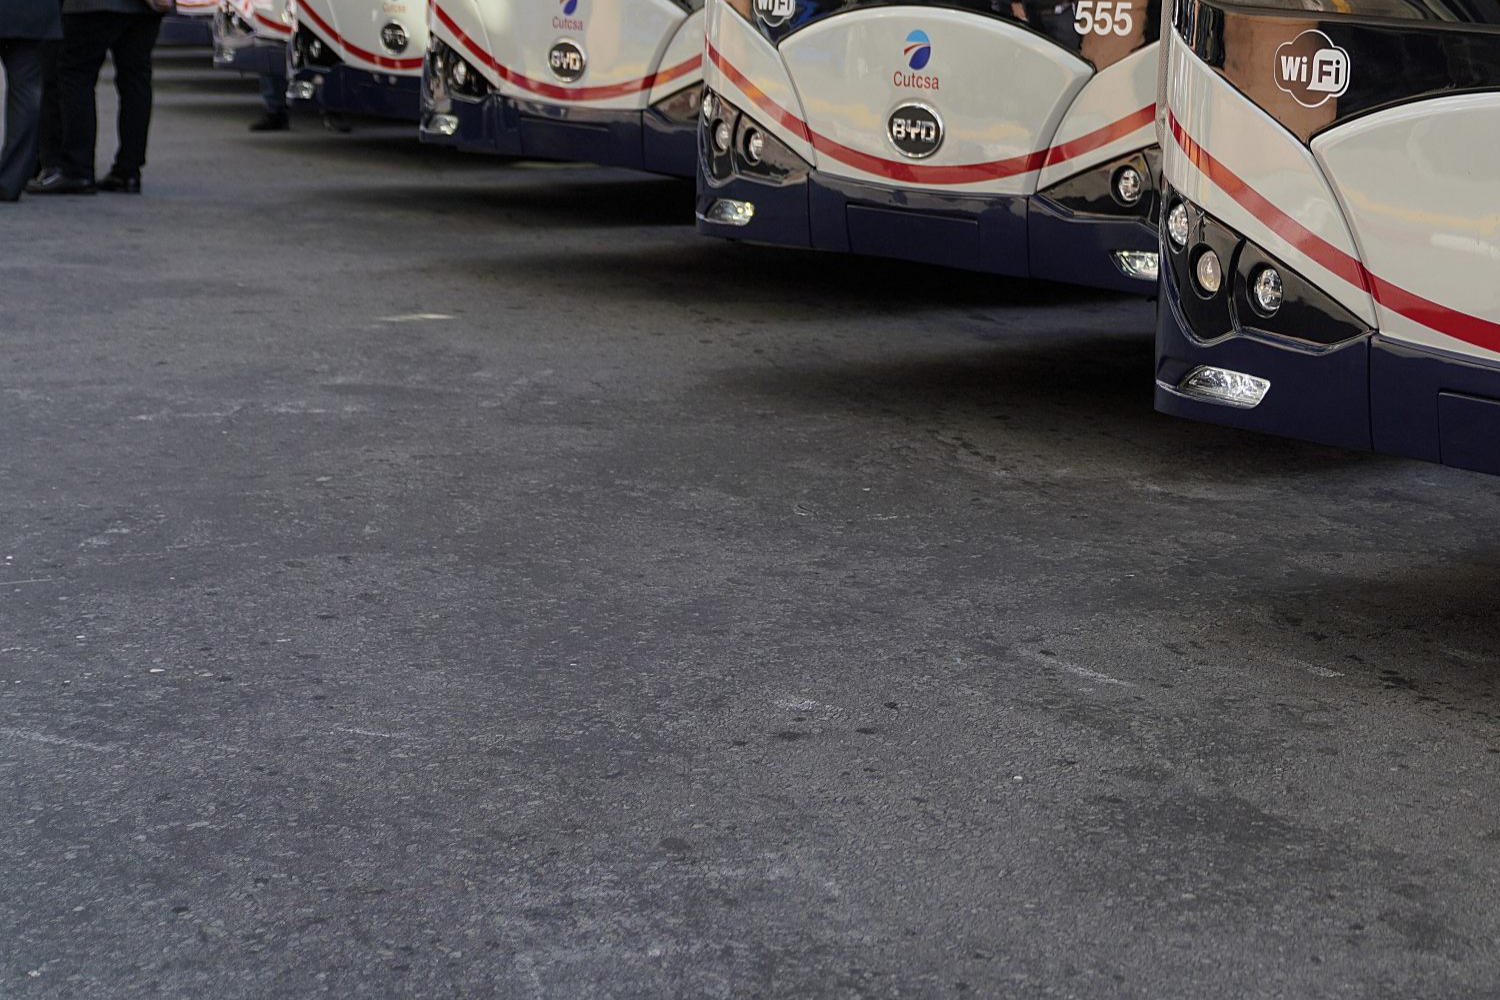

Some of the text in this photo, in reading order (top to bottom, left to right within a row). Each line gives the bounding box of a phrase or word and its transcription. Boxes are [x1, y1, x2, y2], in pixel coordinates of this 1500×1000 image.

[1073, 0, 1133, 37] 555
[893, 71, 939, 90] Cutcsa
[892, 117, 936, 144] BYD
